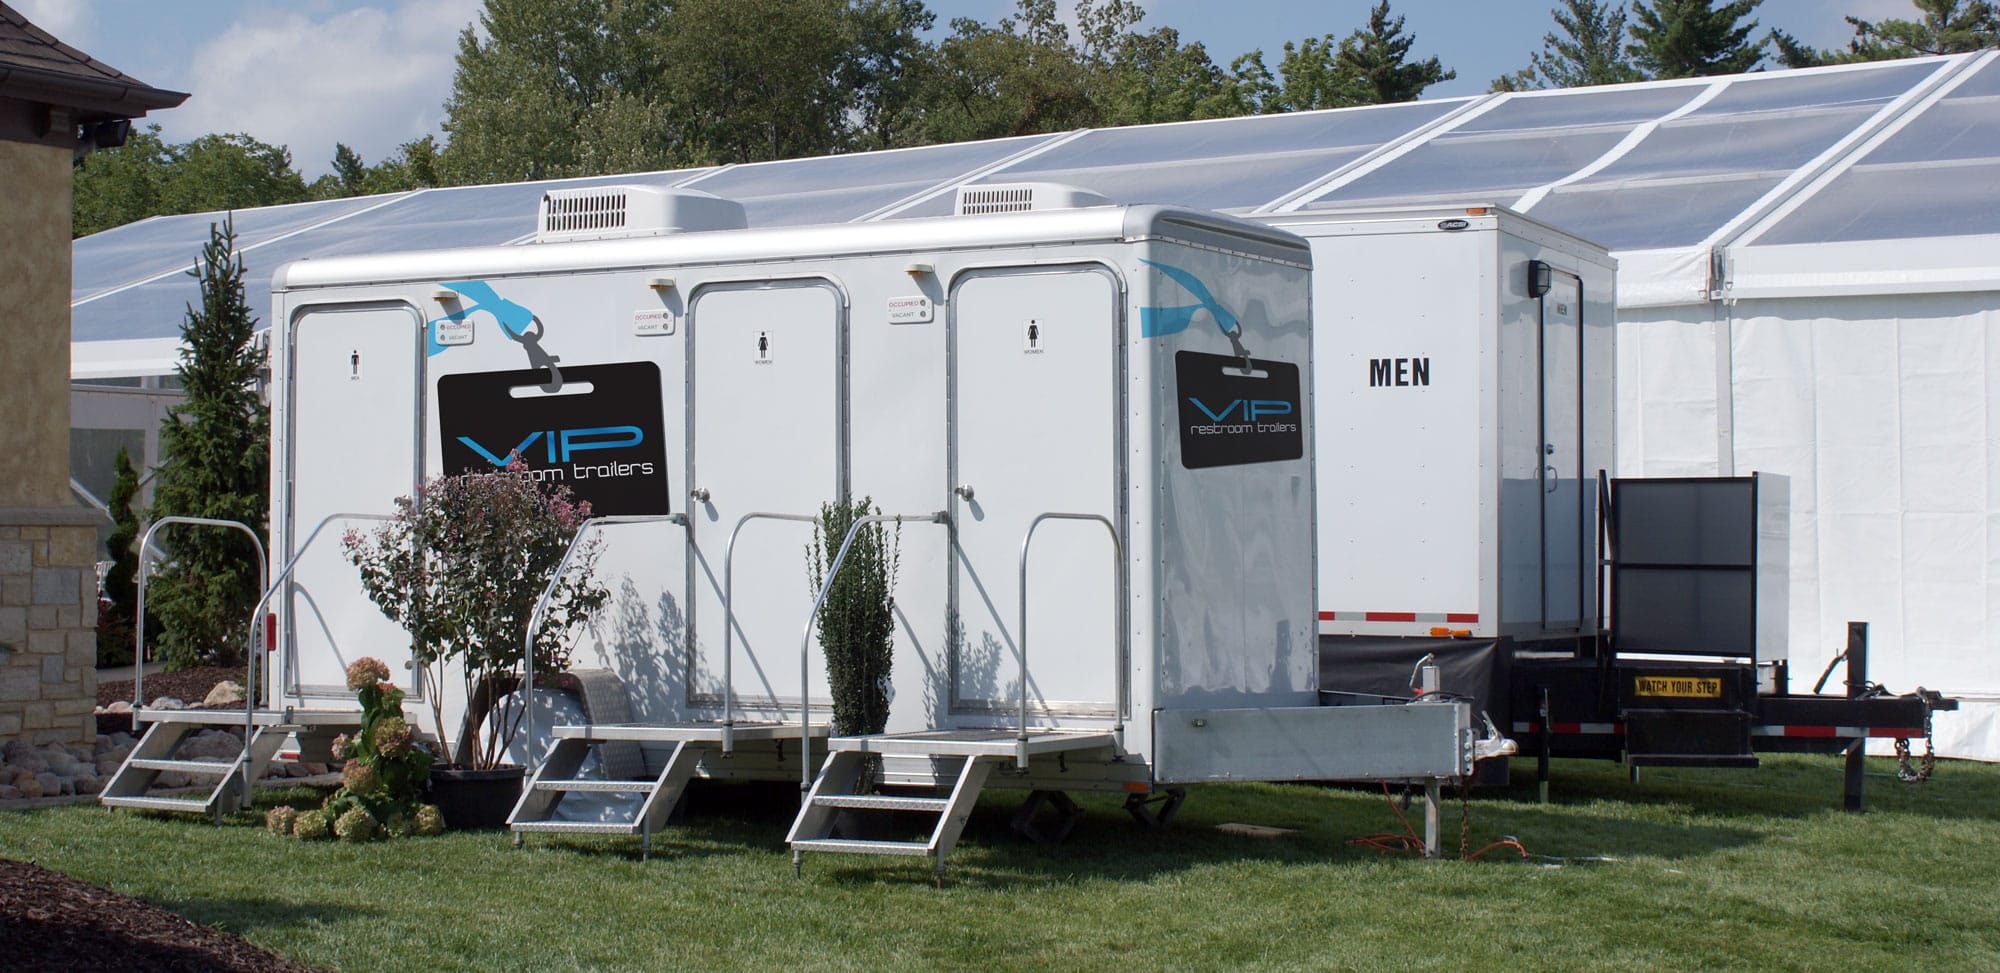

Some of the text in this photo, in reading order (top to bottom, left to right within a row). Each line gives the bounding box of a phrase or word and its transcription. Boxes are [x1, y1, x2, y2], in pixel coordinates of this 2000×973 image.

[892, 311, 914, 319] VACANT
[1369, 357, 1430, 387] MEN
[1188, 397, 1293, 422] VIP
[1190, 421, 1297, 435] restroom trailers
[456, 425, 643, 468] VIP
[573, 460, 654, 480] trailers
[1638, 679, 1718, 695] WATCH YOUR STEP
